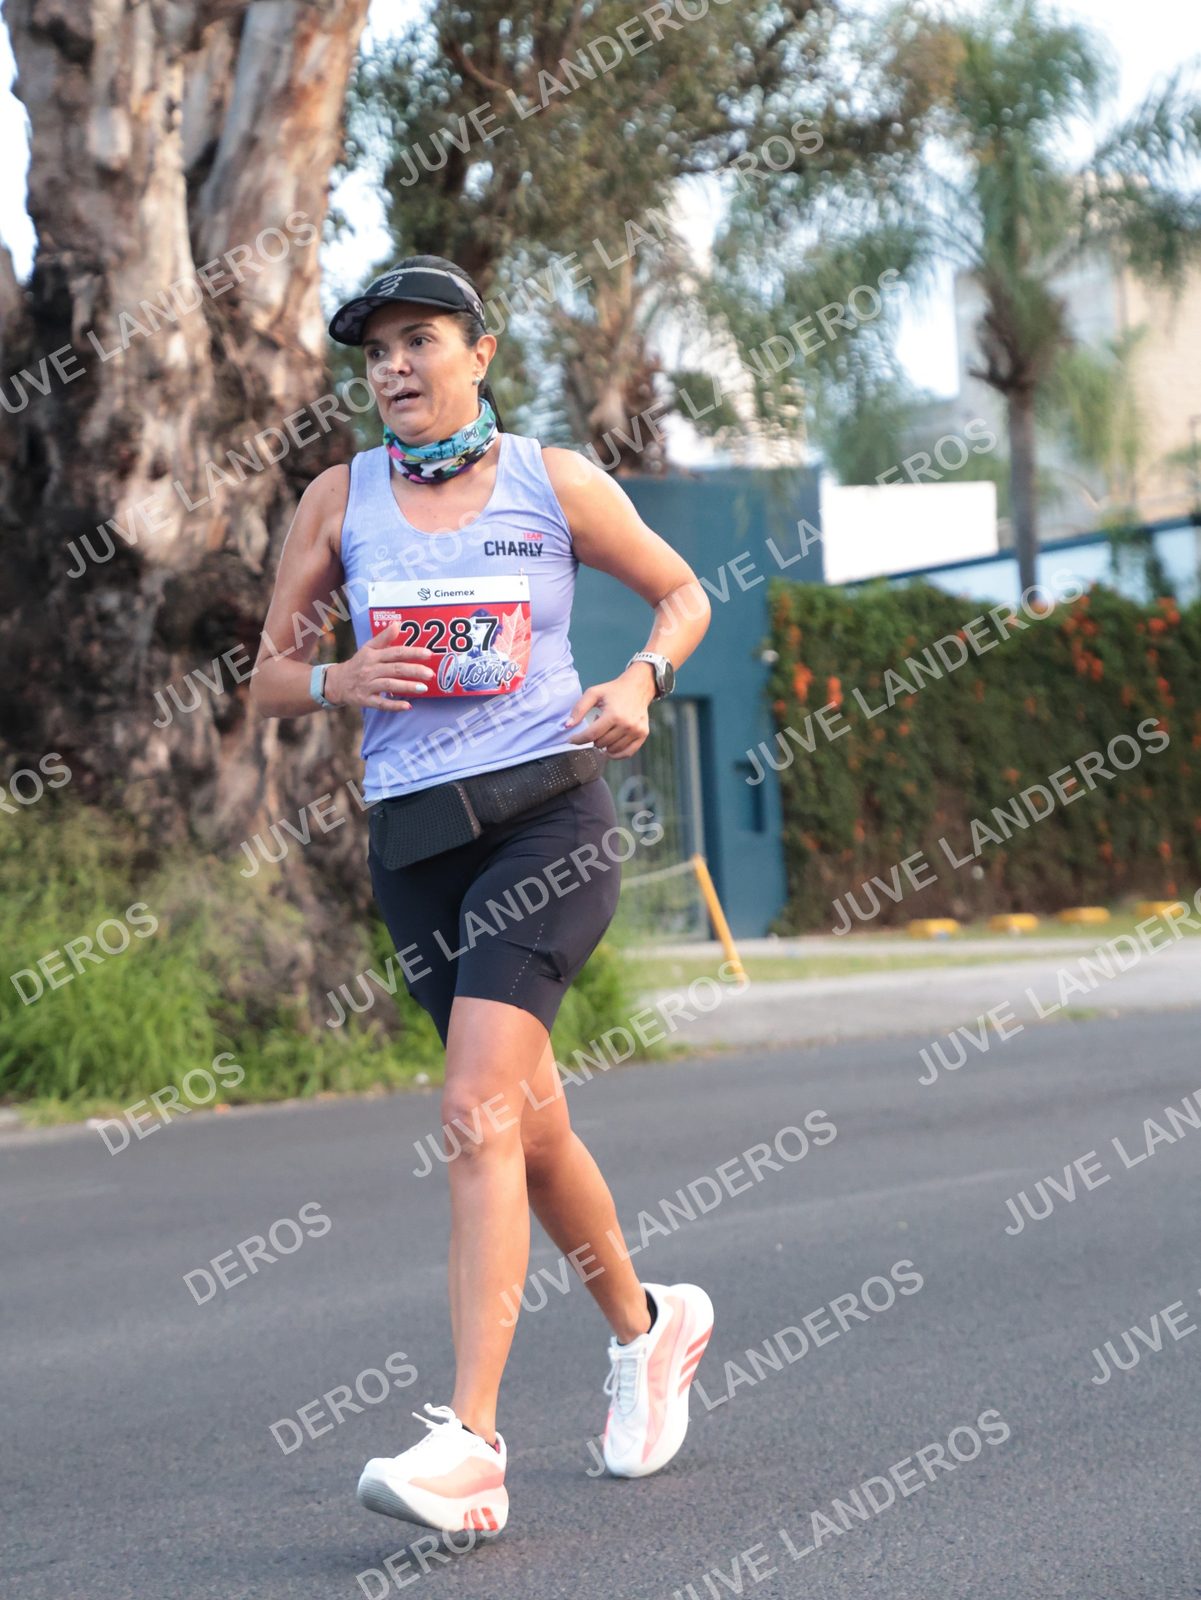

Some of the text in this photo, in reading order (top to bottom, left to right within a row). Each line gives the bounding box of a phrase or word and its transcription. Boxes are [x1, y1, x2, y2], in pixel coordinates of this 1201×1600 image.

[523, 532, 543, 540] TEAM
[484, 540, 544, 557] CHARLY
[434, 588, 475, 598] Cinemex
[400, 617, 499, 654] 2287
